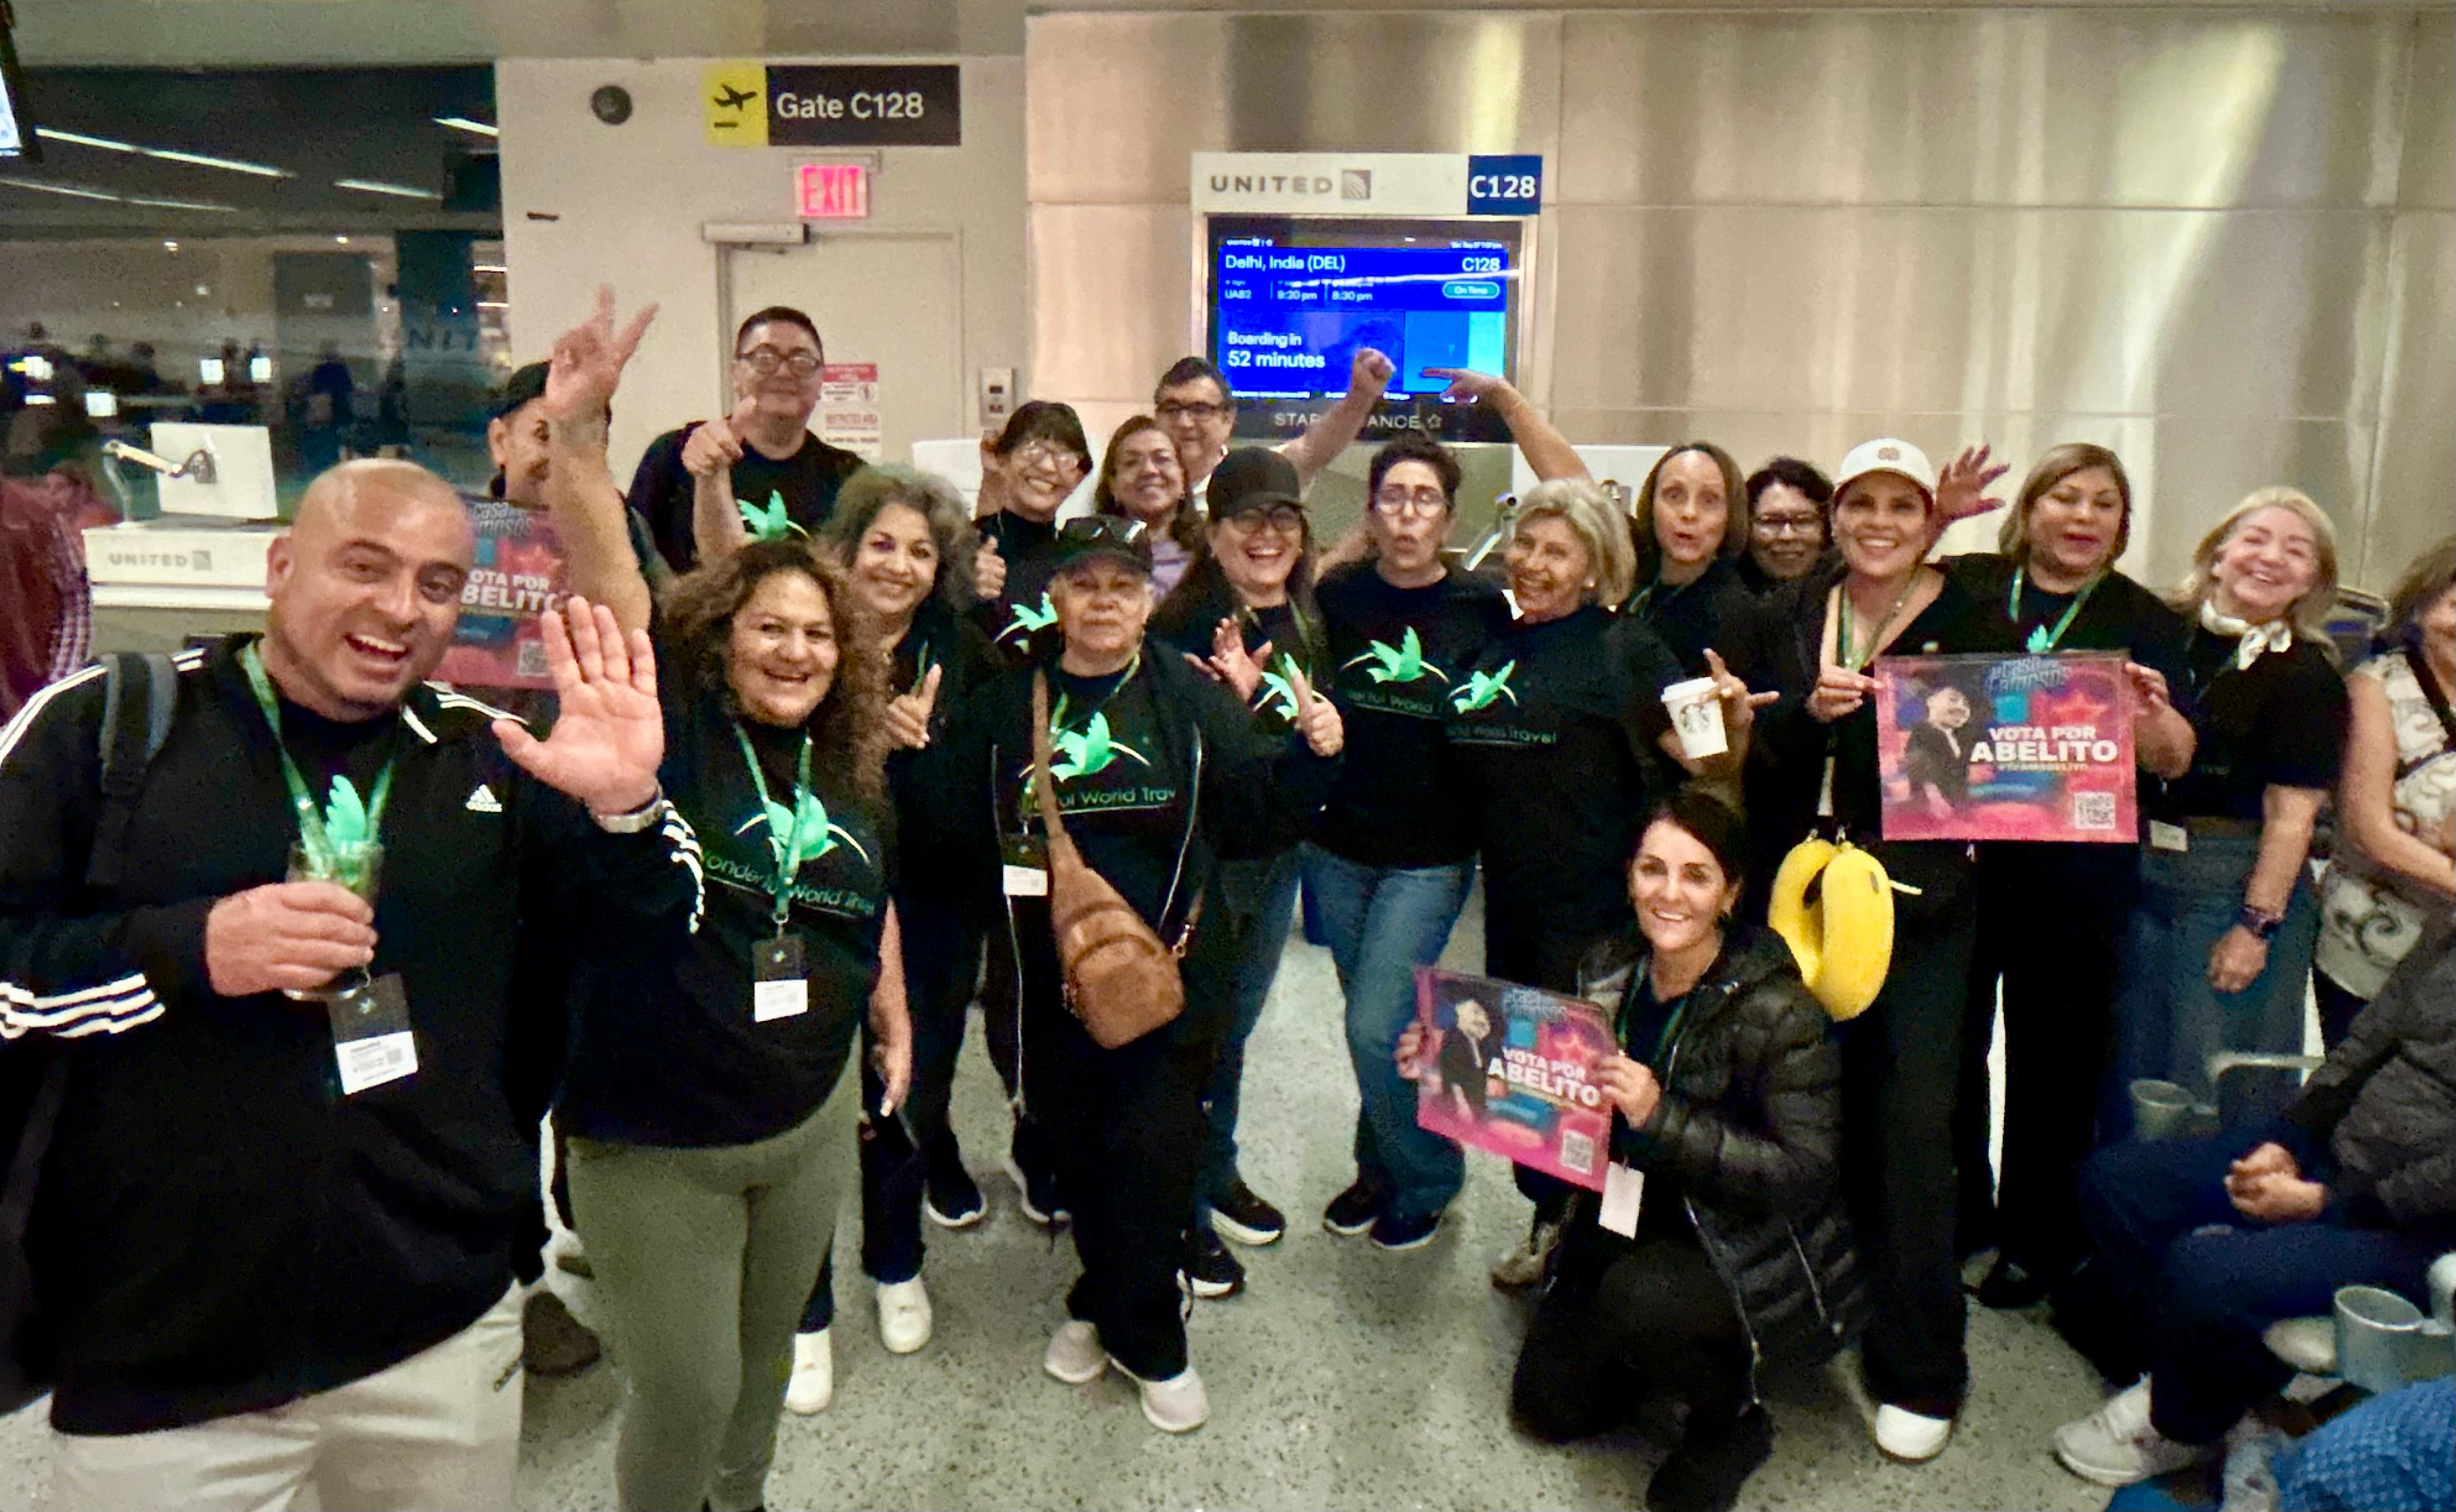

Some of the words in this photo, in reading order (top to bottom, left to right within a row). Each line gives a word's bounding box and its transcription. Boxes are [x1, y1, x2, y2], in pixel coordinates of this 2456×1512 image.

[777, 93, 843, 118] Gate
[850, 92, 924, 118] C128
[803, 166, 859, 213] EXIT
[1210, 174, 1333, 194] UNITED
[1470, 175, 1536, 199] C128
[1225, 254, 1266, 272] Delhi,
[1269, 255, 1304, 270] India
[1307, 254, 1345, 273] (DEL)
[1461, 257, 1500, 271] C128
[1301, 292, 1317, 302] pm
[1356, 293, 1372, 303] pm
[1227, 331, 1288, 349] Boarding
[1289, 332, 1302, 346] in
[1228, 351, 1251, 367] 52
[1256, 351, 1325, 369] minutes
[1366, 414, 1421, 429] ANCE
[108, 553, 188, 566] UNITED
[469, 569, 507, 587] OTA
[513, 574, 550, 591] POR
[461, 583, 558, 612] BELIT
[1988, 726, 2047, 741] VOTA
[2051, 725, 2097, 740] POR
[1969, 740, 2118, 762] ABELITO
[1080, 787, 1136, 805] World
[1140, 786, 1176, 802] Trav
[1501, 1046, 1549, 1069] VOTA
[1549, 1060, 1588, 1083] POR
[1487, 1057, 1602, 1108] ABELITO
